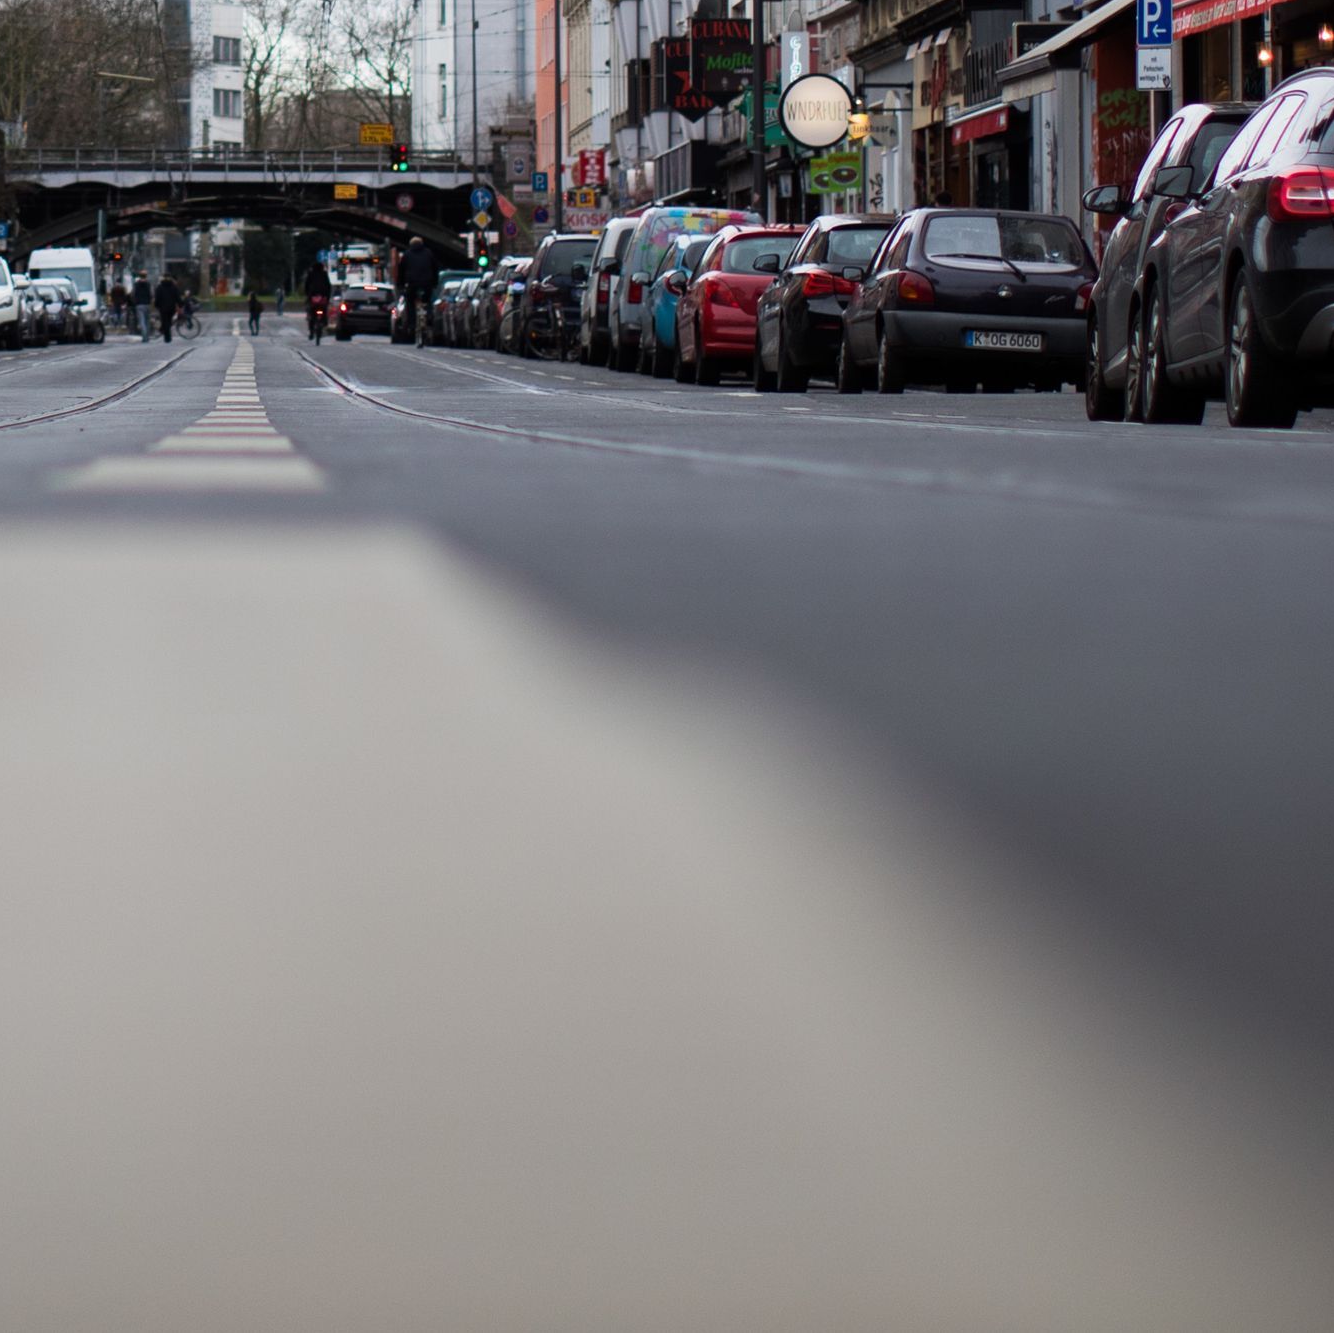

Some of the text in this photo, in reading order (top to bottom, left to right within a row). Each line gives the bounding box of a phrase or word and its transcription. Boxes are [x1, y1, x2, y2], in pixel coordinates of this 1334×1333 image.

[692, 21, 750, 40] CUBANA
[568, 214, 609, 227] KIOSK
[974, 333, 1040, 348] K OG 6060
